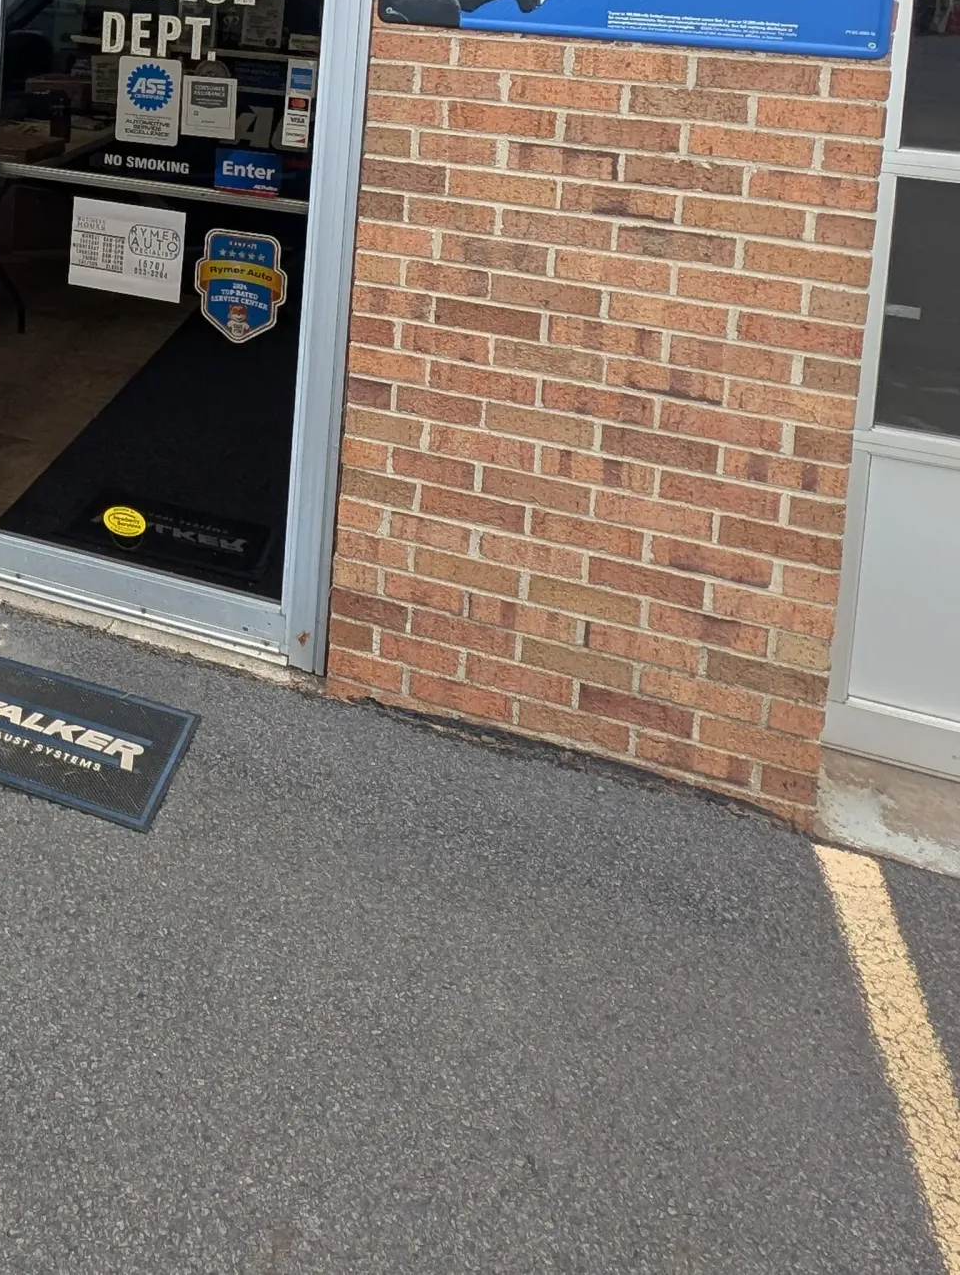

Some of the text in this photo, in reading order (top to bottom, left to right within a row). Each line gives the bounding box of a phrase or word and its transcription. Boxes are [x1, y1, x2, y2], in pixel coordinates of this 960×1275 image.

[101, 11, 217, 62] DEPT.
[131, 77, 167, 96] ASE
[124, 118, 171, 128] AUTOMOTIVE
[124, 127, 170, 137] EXCELLENCE
[103, 153, 189, 175] NO SMOKING
[222, 160, 276, 181] Enter
[131, 225, 178, 243] RYMER
[131, 236, 178, 253] AUTO
[209, 266, 272, 282] Rymer Auto
[210, 295, 268, 310] SERVICE CENTER
[35, 742, 101, 772] SYSTEMS
